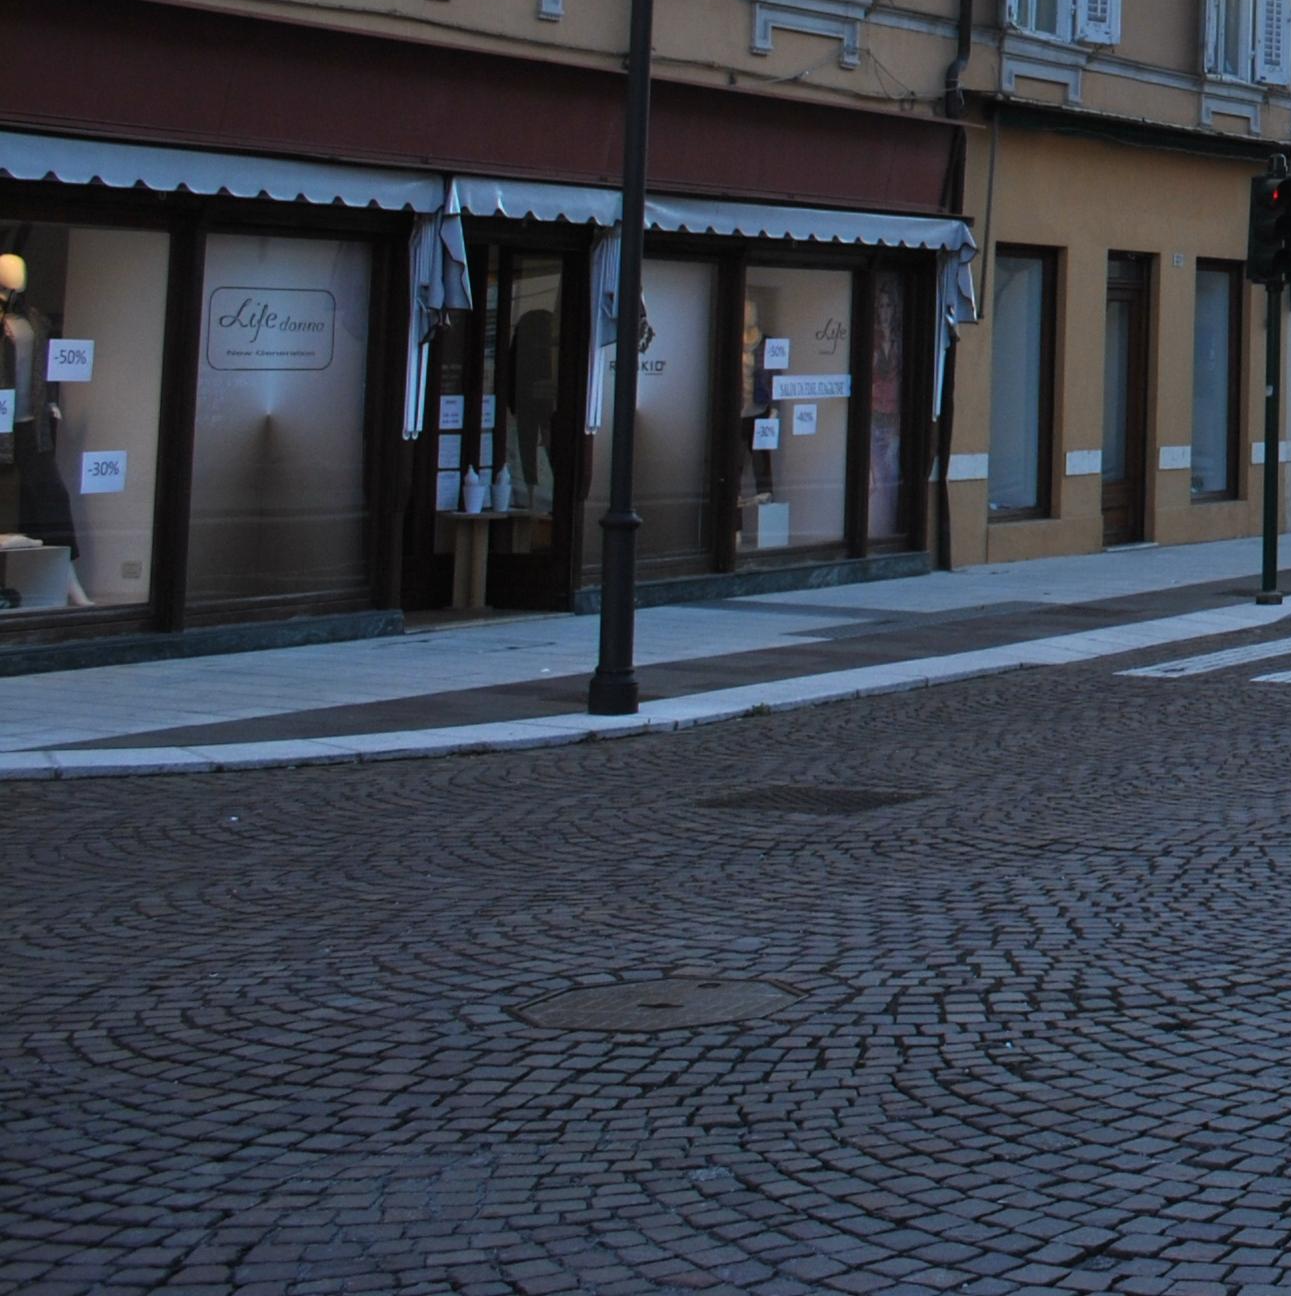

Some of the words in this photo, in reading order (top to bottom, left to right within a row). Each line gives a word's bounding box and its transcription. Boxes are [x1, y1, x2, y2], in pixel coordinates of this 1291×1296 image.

[218, 297, 278, 344] Life
[279, 315, 325, 333] donna
[53, 349, 87, 365] -50%
[87, 460, 120, 476] -30%
